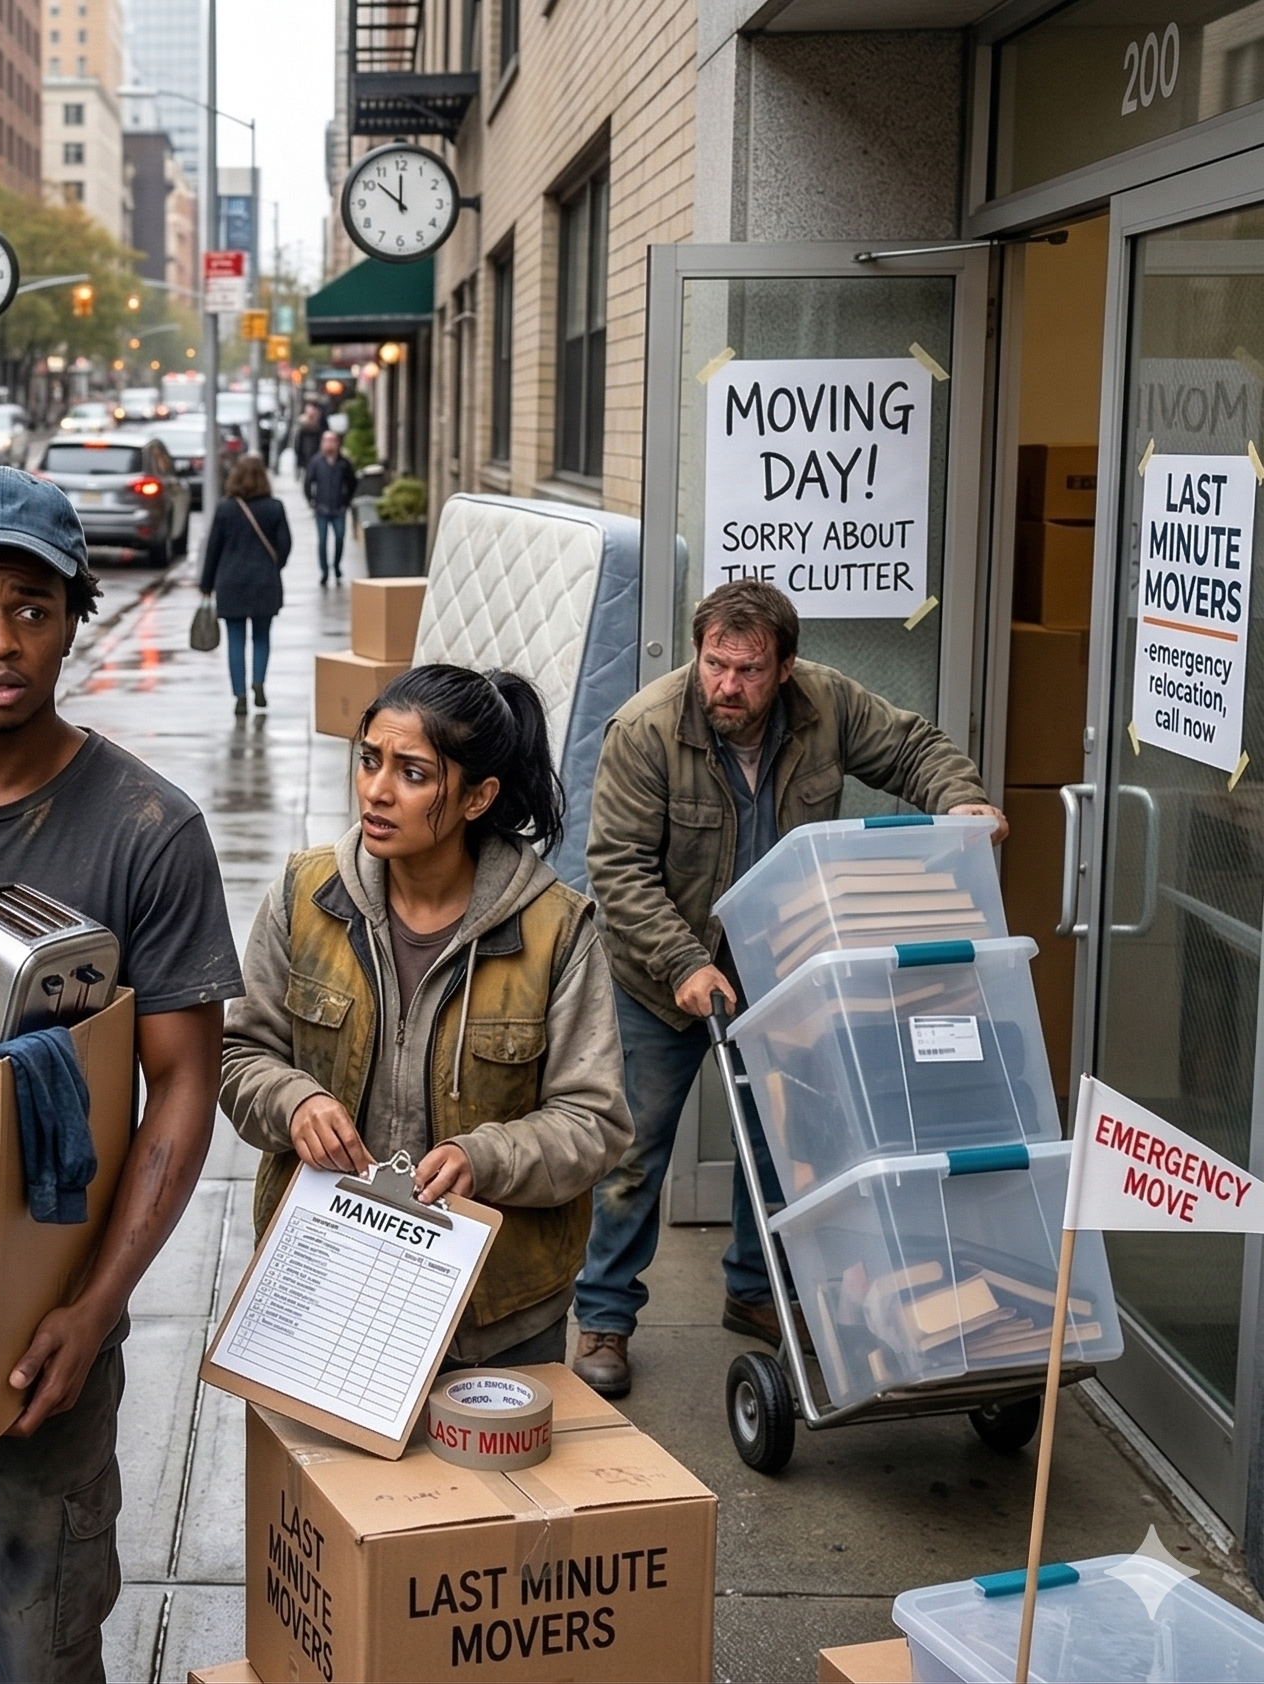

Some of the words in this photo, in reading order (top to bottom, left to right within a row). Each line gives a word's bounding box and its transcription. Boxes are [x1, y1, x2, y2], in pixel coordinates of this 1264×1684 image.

[1121, 21, 1180, 117] 200
[362, 179, 376, 191] 10
[376, 166, 387, 178] 11
[396, 160, 408, 171] 12
[419, 166, 423, 177] 1
[430, 179, 439, 190] 2
[357, 198, 367, 210] 9
[363, 217, 372, 229] 8
[428, 217, 437, 228] 4
[435, 198, 444, 210] 3
[378, 230, 386, 243] 7
[396, 235, 405, 247] 6
[416, 230, 424, 242] 5
[726, 381, 915, 436] MOVING
[759, 443, 878, 503] DAY!
[1166, 473, 1228, 516] LAST
[722, 521, 813, 554] SORRY
[823, 519, 915, 551] ABOUT
[1149, 521, 1242, 570] MINUTE
[788, 562, 914, 592] CLUTTER
[1144, 569, 1242, 623] MOVERS
[1149, 672, 1227, 719] relocation,
[1155, 707, 1180, 733] call
[1183, 717, 1216, 743] now
[1095, 1114, 1252, 1207] EMERGENCY
[1123, 1167, 1198, 1223] MOVE
[329, 1194, 441, 1250] MANIFEST
[427, 1411, 472, 1452] LAST
[478, 1419, 551, 1455] MINUTE
[281, 1489, 325, 1573] LAST
[269, 1523, 333, 1636] MINUTE
[409, 1566, 507, 1619] LAST
[521, 1547, 668, 1606] MINUTE
[267, 1566, 333, 1683] MOVERS
[451, 1606, 616, 1668] MOVERS
